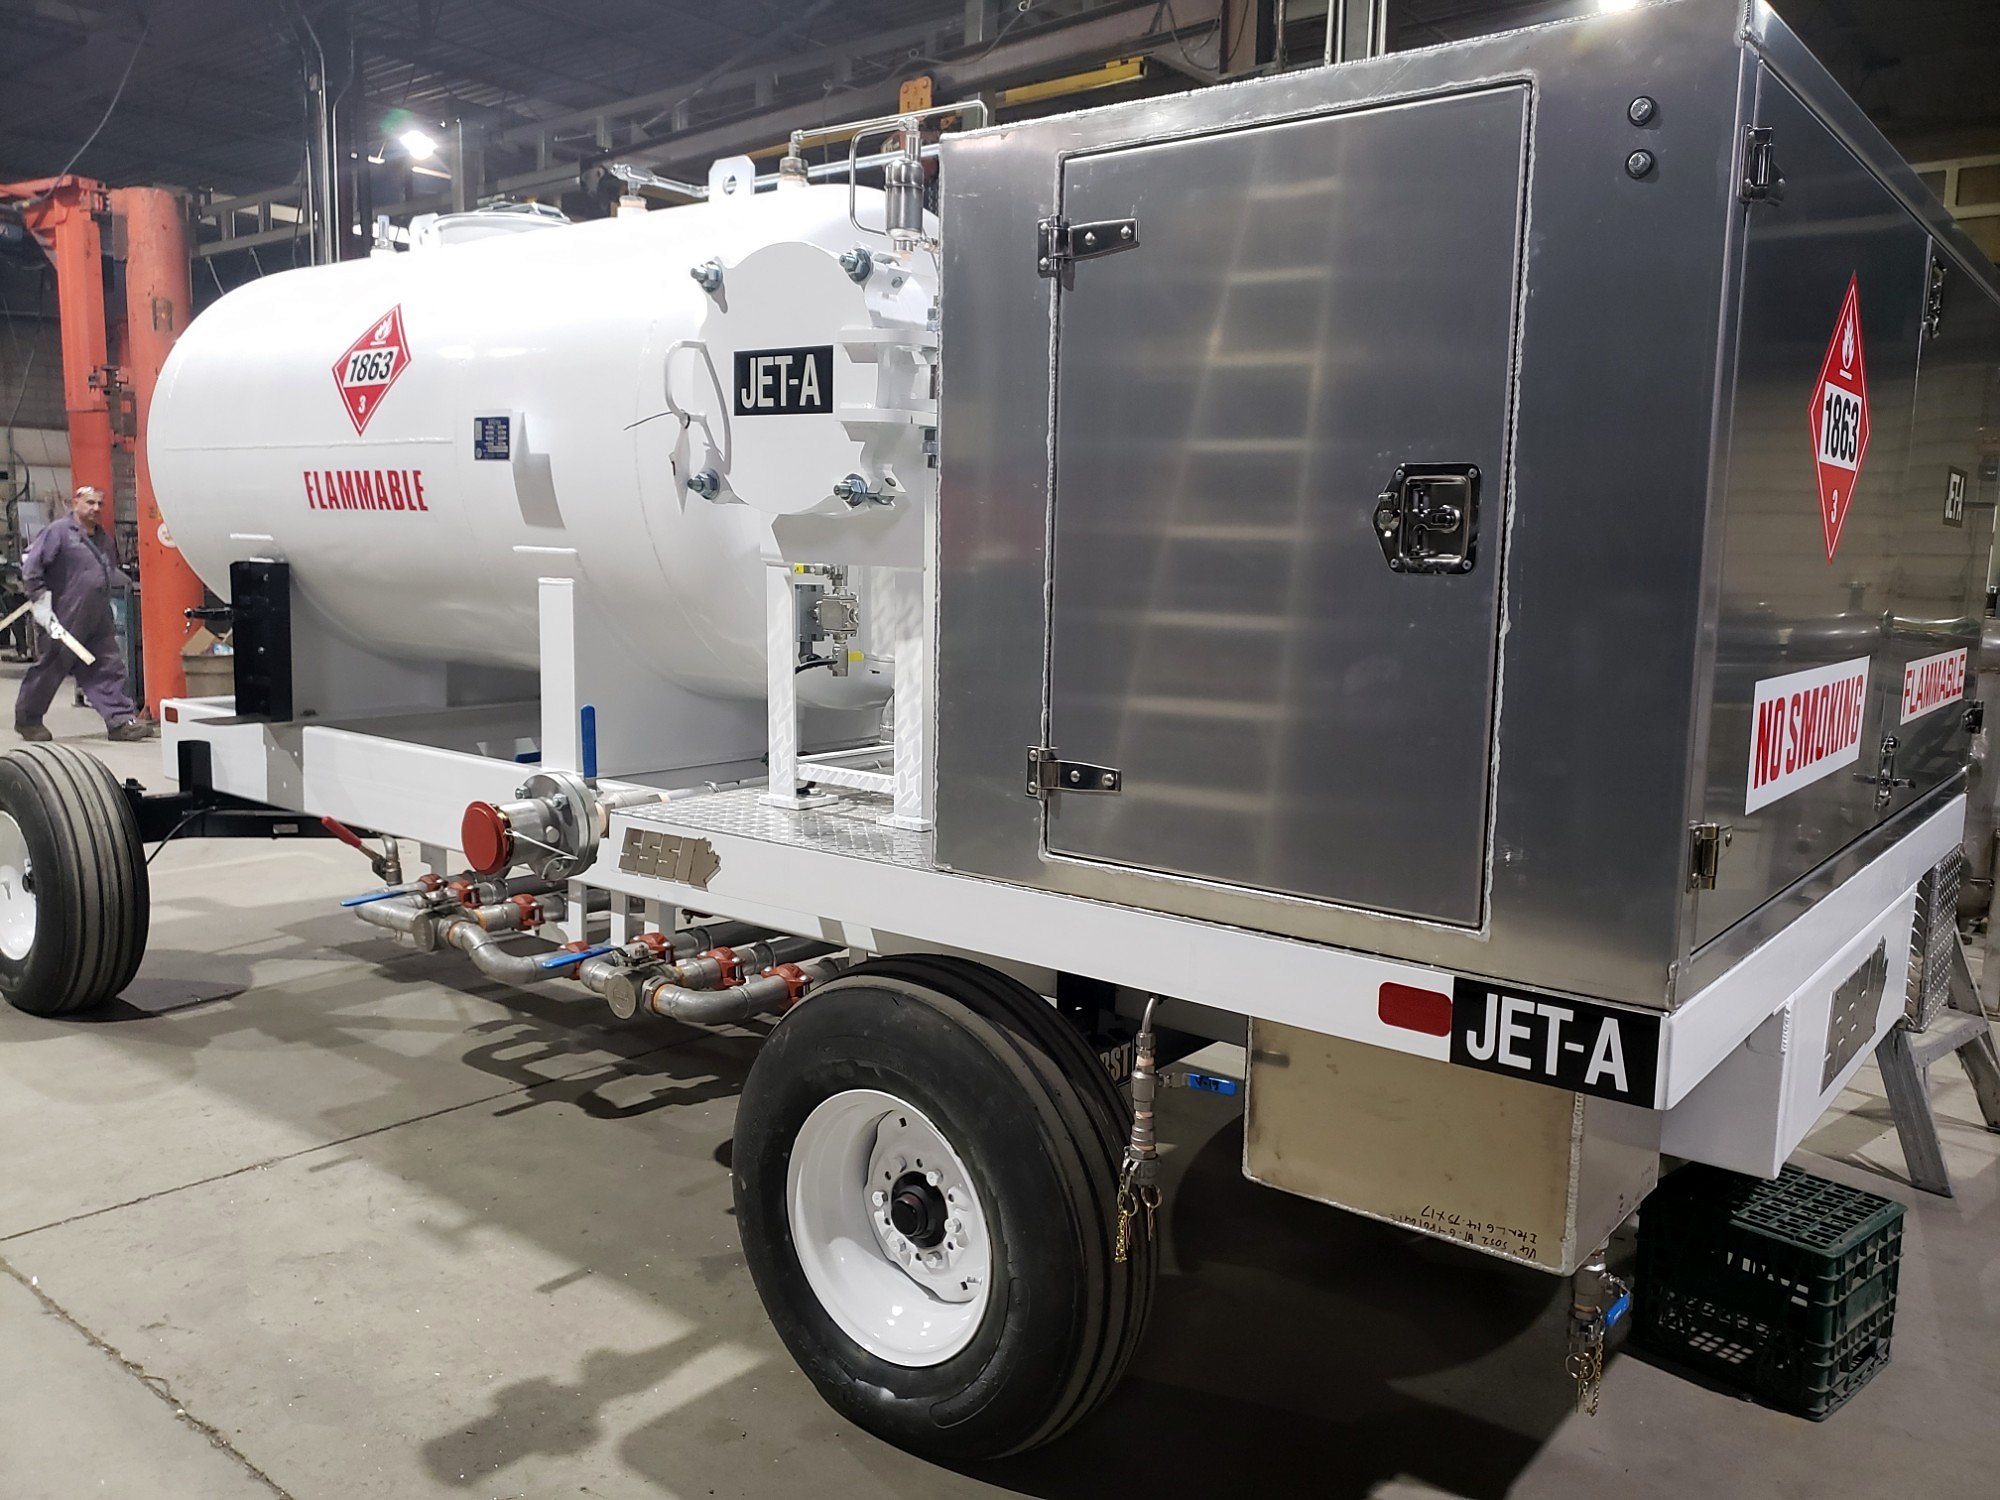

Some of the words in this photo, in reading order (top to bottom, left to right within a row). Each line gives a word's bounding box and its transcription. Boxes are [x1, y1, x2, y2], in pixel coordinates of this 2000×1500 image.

[349, 350, 394, 383] 1863
[741, 353, 821, 409] JET-A
[358, 394, 367, 414] 3
[1825, 392, 1859, 464] 1863
[303, 469, 429, 512] FLAMMABLE
[1830, 488, 1838, 524] 3
[1902, 653, 1966, 717] FLAMMABLE
[1753, 696, 1786, 790] NO
[1785, 674, 1864, 775] SMOKING
[1466, 992, 1629, 1093] JET-A
